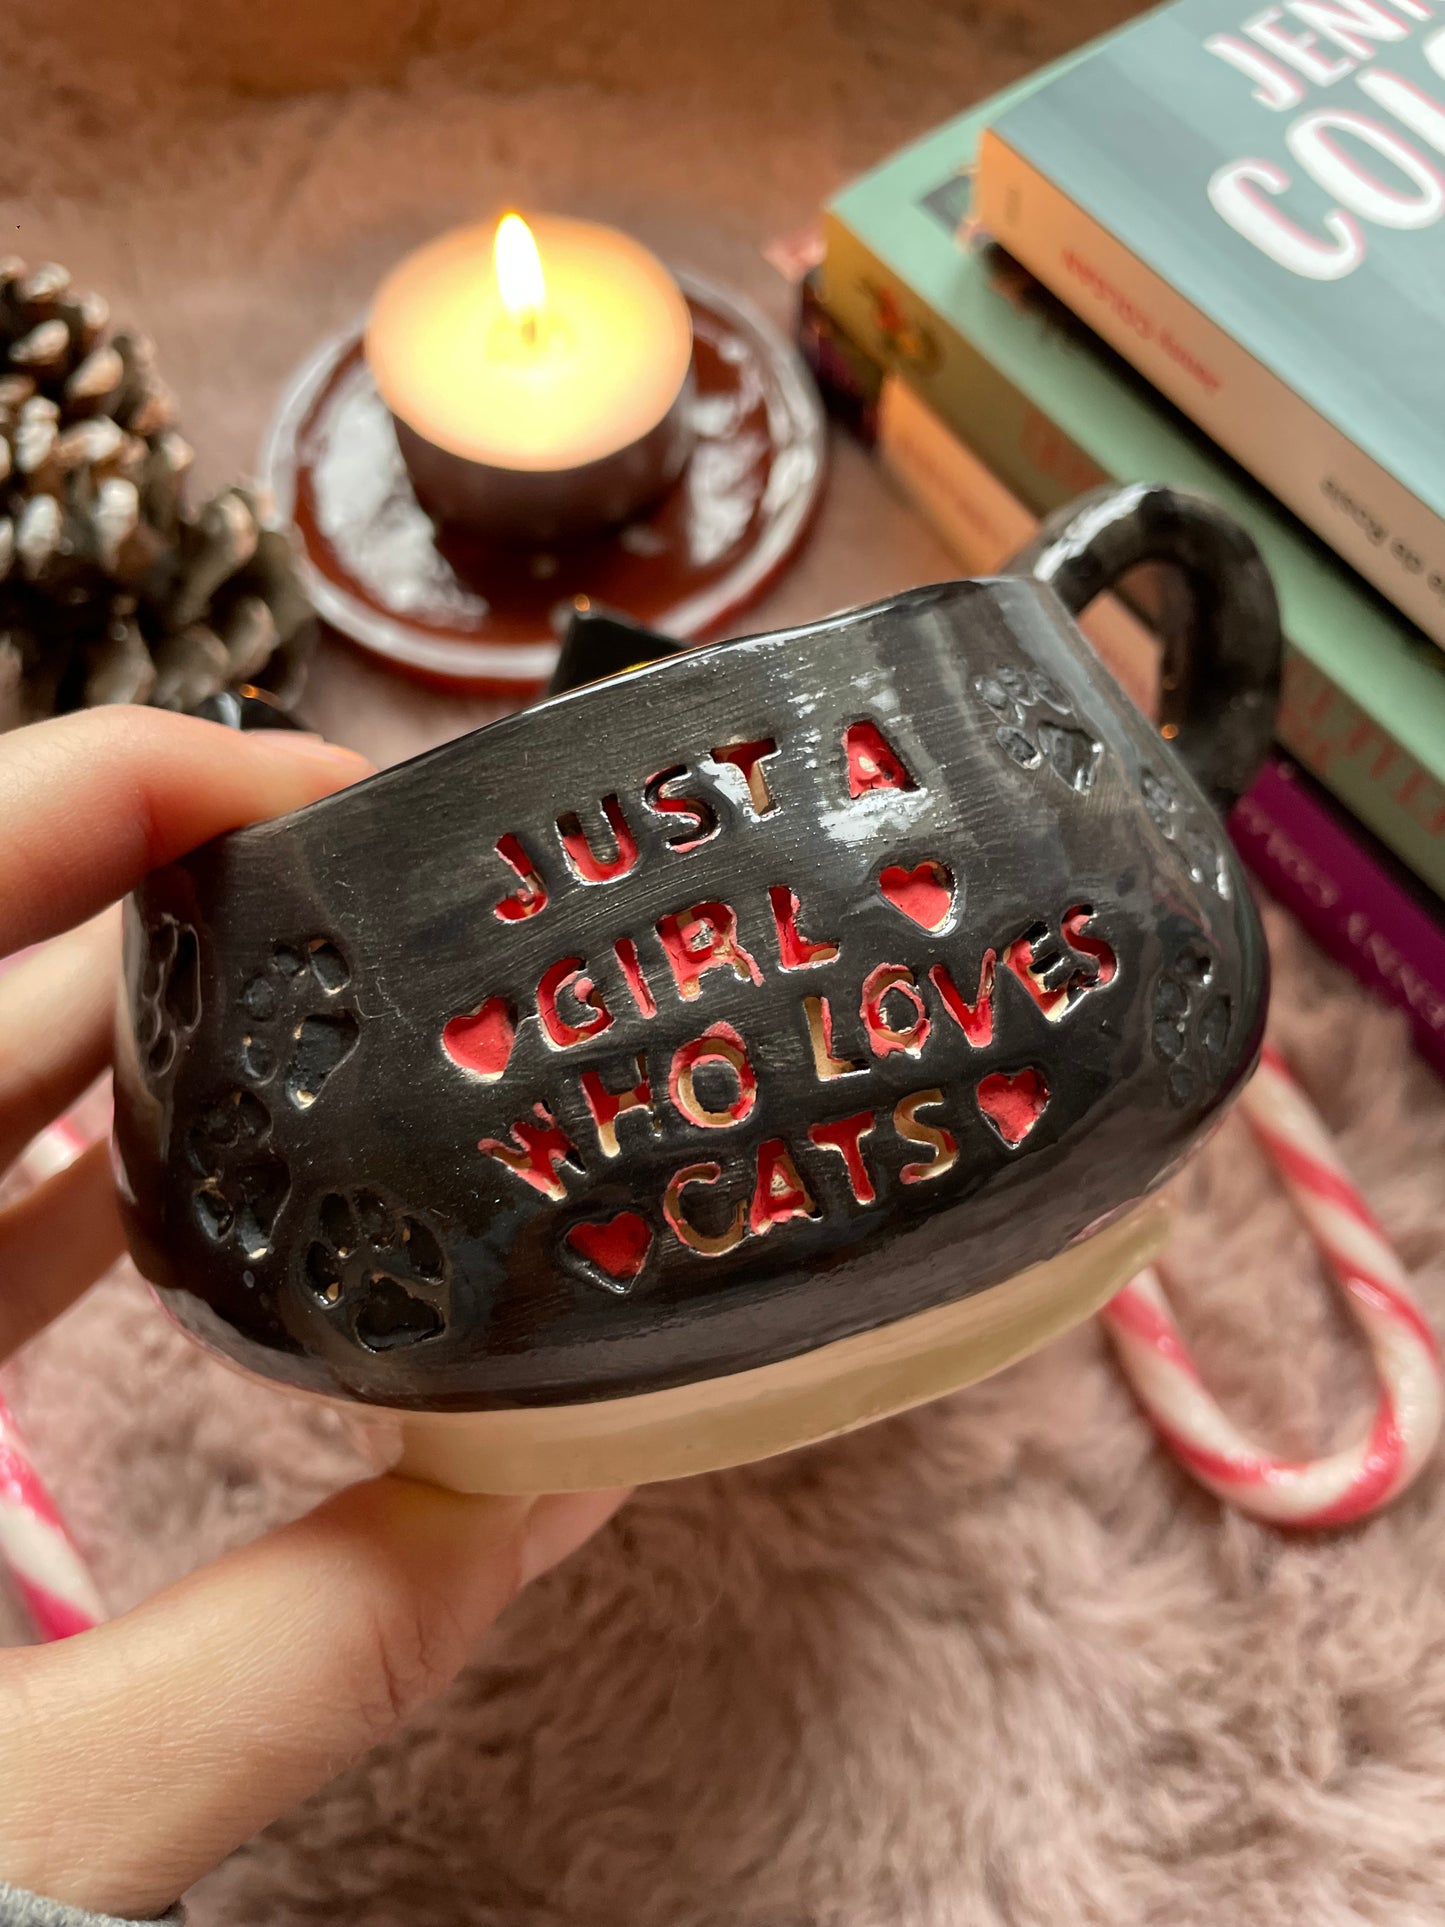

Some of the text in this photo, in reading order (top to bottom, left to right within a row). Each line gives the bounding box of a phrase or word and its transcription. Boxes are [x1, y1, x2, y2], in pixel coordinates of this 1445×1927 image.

[495, 720, 920, 922] JUST A
[478, 1021, 757, 1200] WHO
[803, 904, 1118, 1081] LOVES
[536, 885, 840, 1049] GIRL
[663, 1089, 960, 1257] CATS
